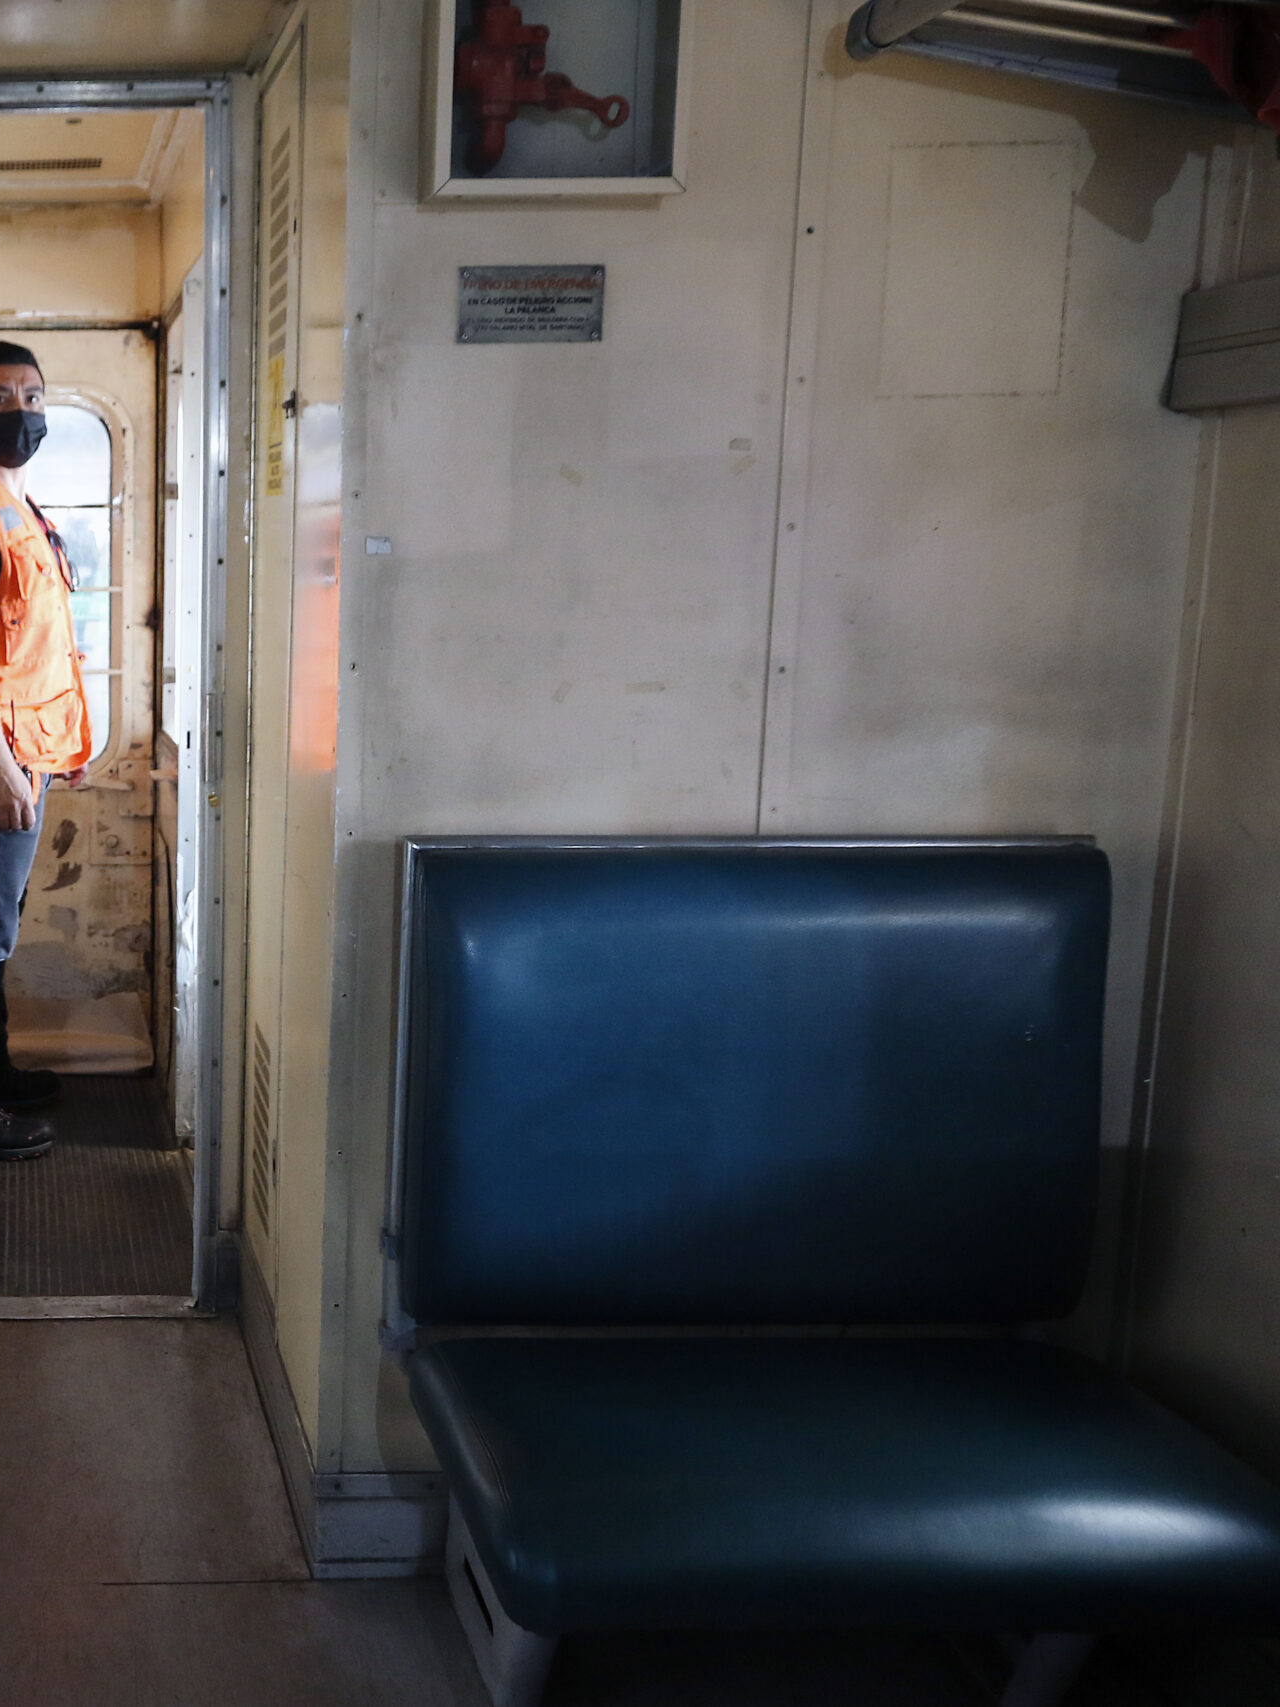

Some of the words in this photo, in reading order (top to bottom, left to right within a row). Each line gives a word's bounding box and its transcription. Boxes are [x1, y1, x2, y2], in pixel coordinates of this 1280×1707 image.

[480, 297, 505, 305] CASO
[504, 306, 516, 314] LA
[517, 305, 556, 314] PALANCA
